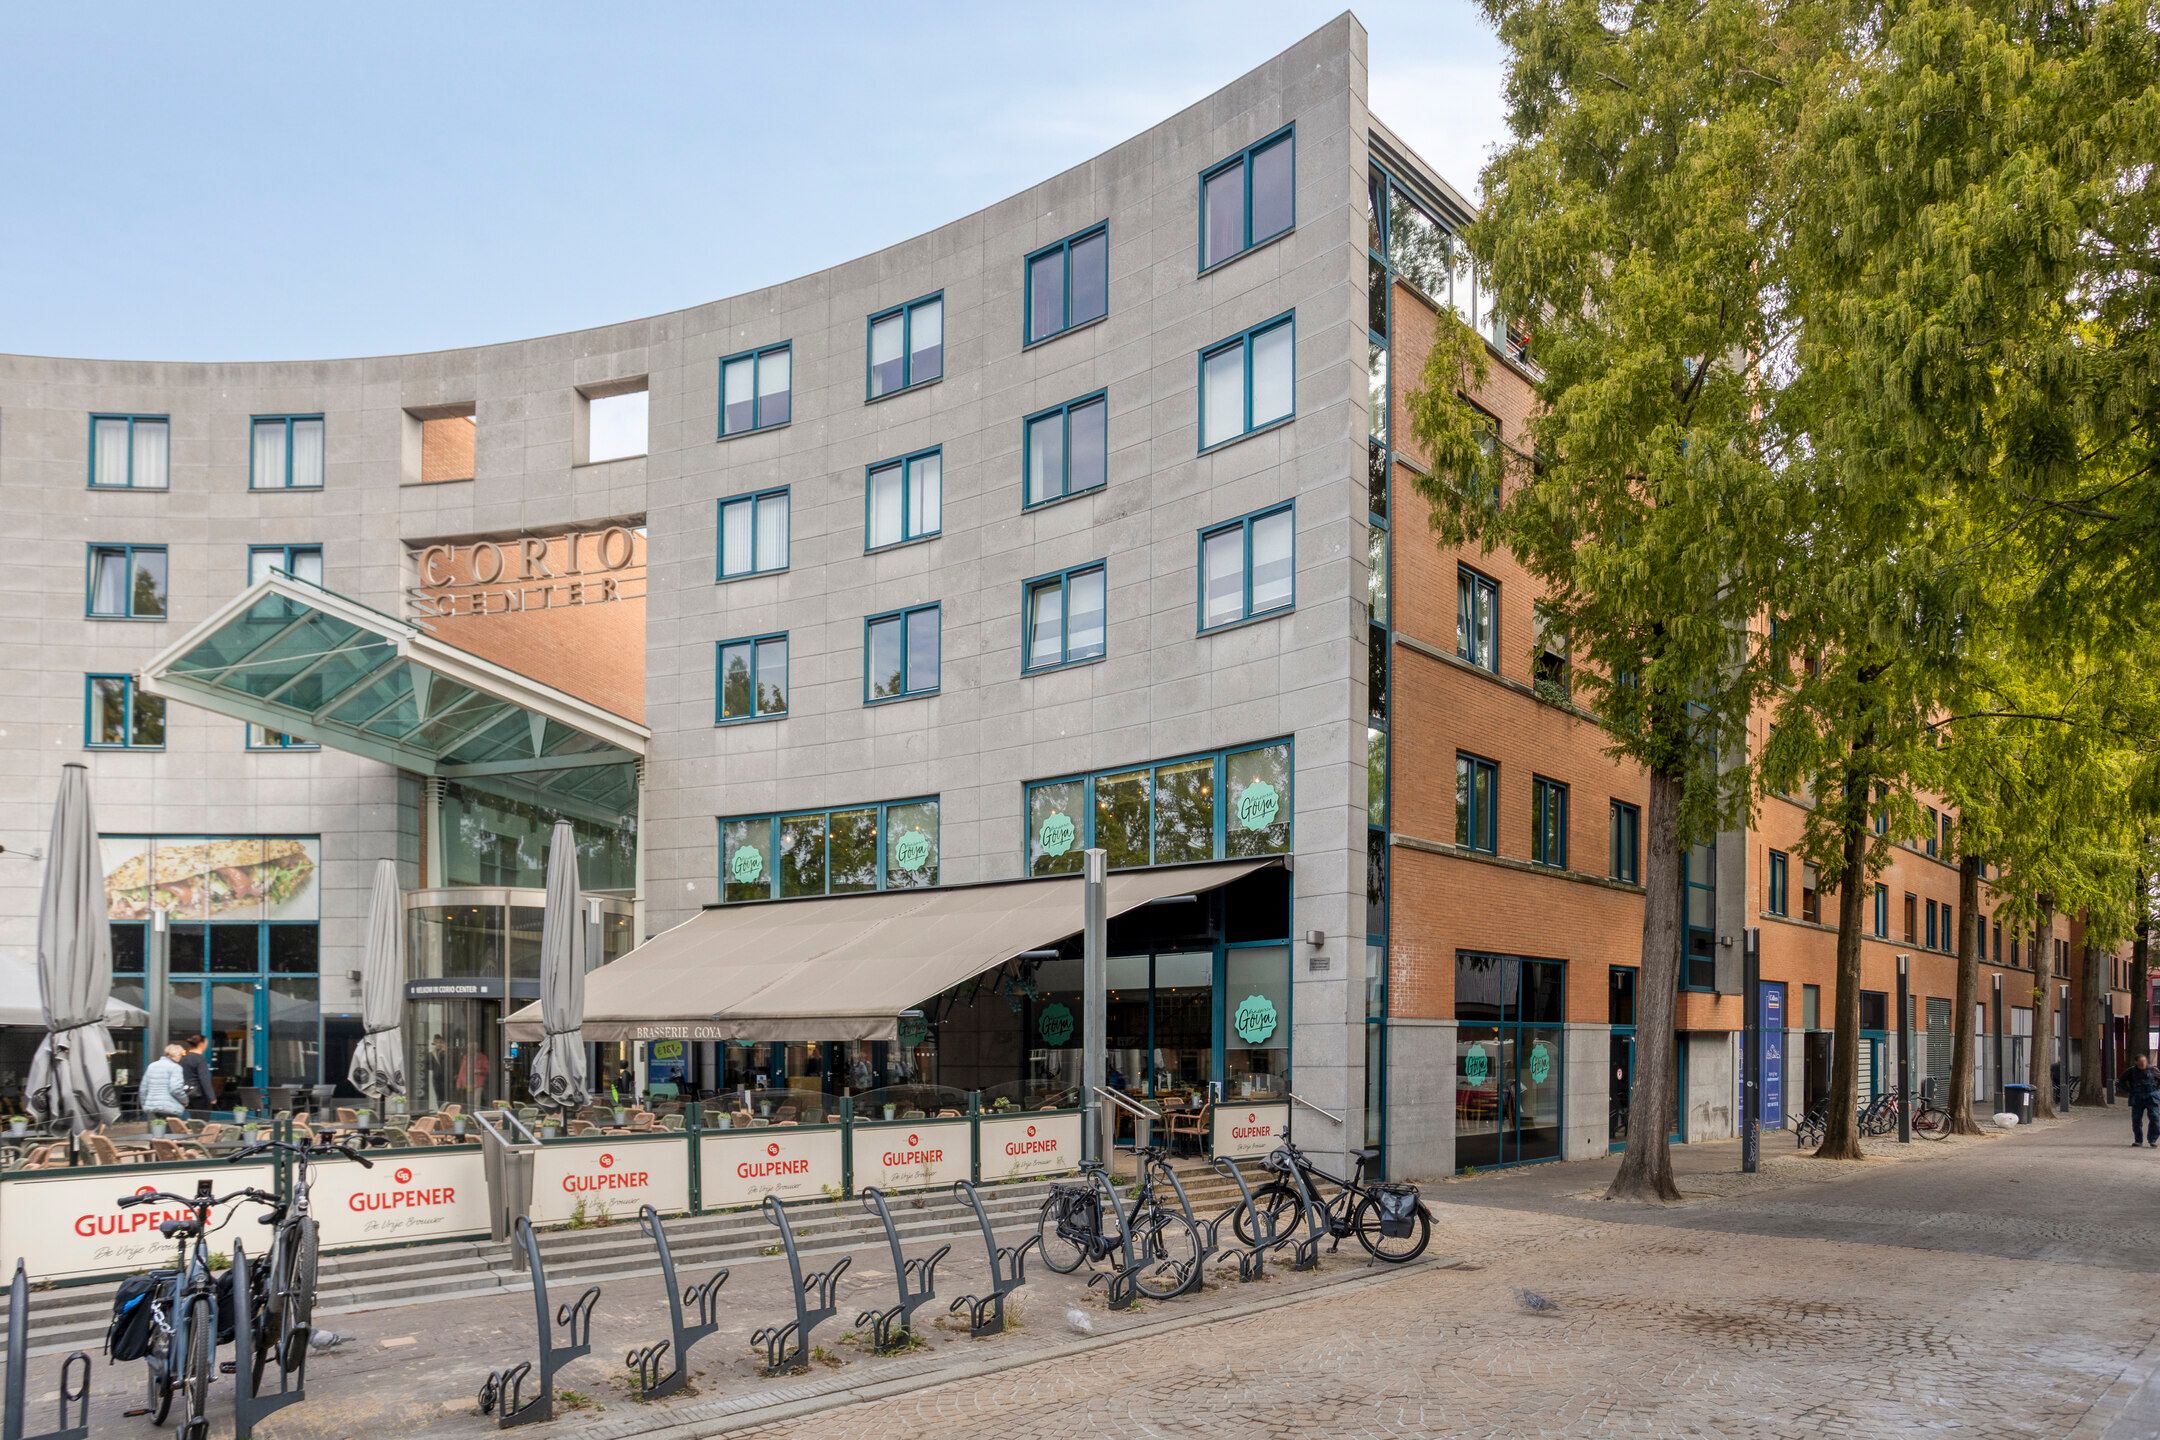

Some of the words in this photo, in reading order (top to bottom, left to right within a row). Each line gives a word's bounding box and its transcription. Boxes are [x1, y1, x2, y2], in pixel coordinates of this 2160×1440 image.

[418, 526, 634, 587] CORIO
[436, 578, 622, 616] CENTER
[1241, 797, 1276, 822] Goya
[1043, 826, 1072, 848] Goya
[898, 843, 927, 863] Goya
[735, 857, 760, 876] Goya
[1041, 1015, 1072, 1035] Goya
[1239, 1009, 1274, 1034] Goya
[637, 1026, 689, 1038] BRASSERIE
[694, 1026, 722, 1038] GOYA
[1231, 1125, 1271, 1139] GULPENER
[1005, 1139, 1057, 1156] GULPENER
[882, 1149, 943, 1167] GULPENER
[737, 1160, 809, 1179] GULPENER
[562, 1172, 649, 1193] GULPENER
[349, 1187, 456, 1212] GULPENER
